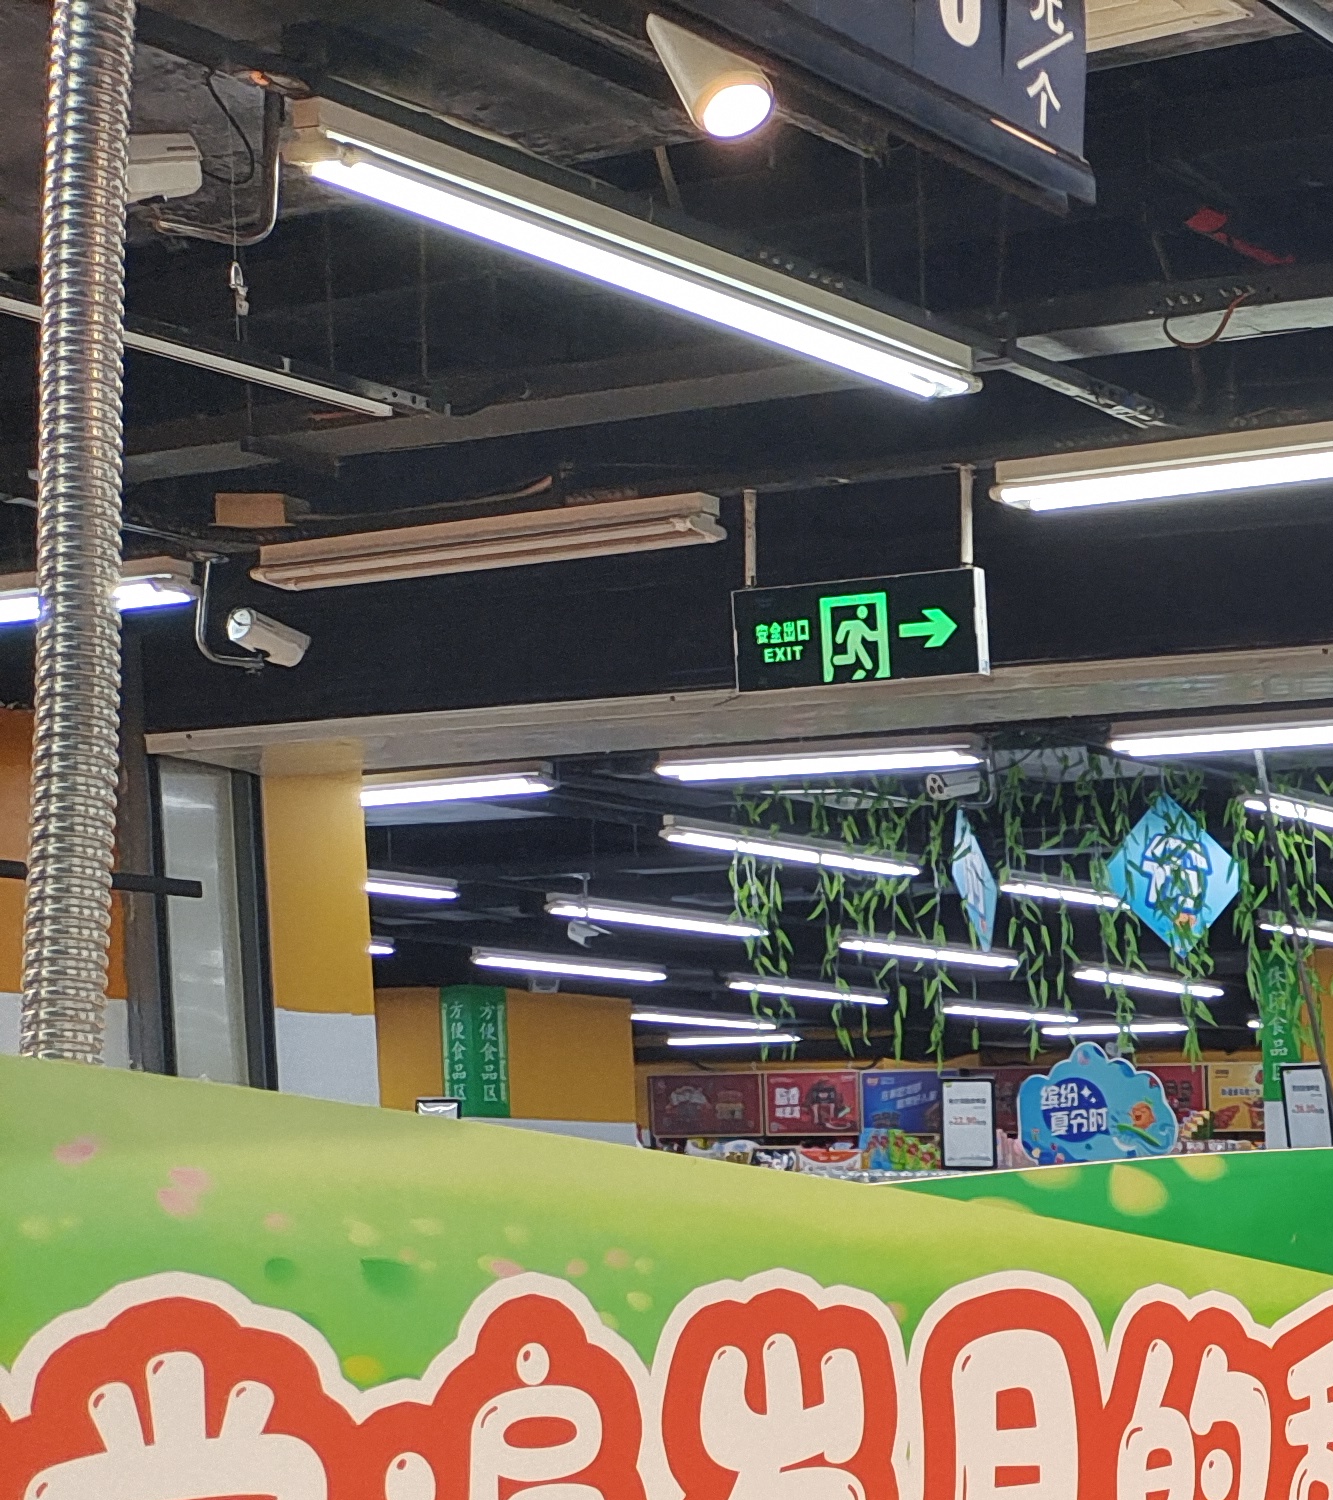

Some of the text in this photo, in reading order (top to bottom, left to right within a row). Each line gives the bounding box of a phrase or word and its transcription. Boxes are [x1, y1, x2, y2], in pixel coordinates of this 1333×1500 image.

[756, 619, 810, 645] 安全出口
[764, 646, 803, 664] EXIT
[450, 1001, 467, 1100] 方便食品区
[480, 1002, 498, 1102] 方便食品区
[1041, 1082, 1079, 1109] 缤纷
